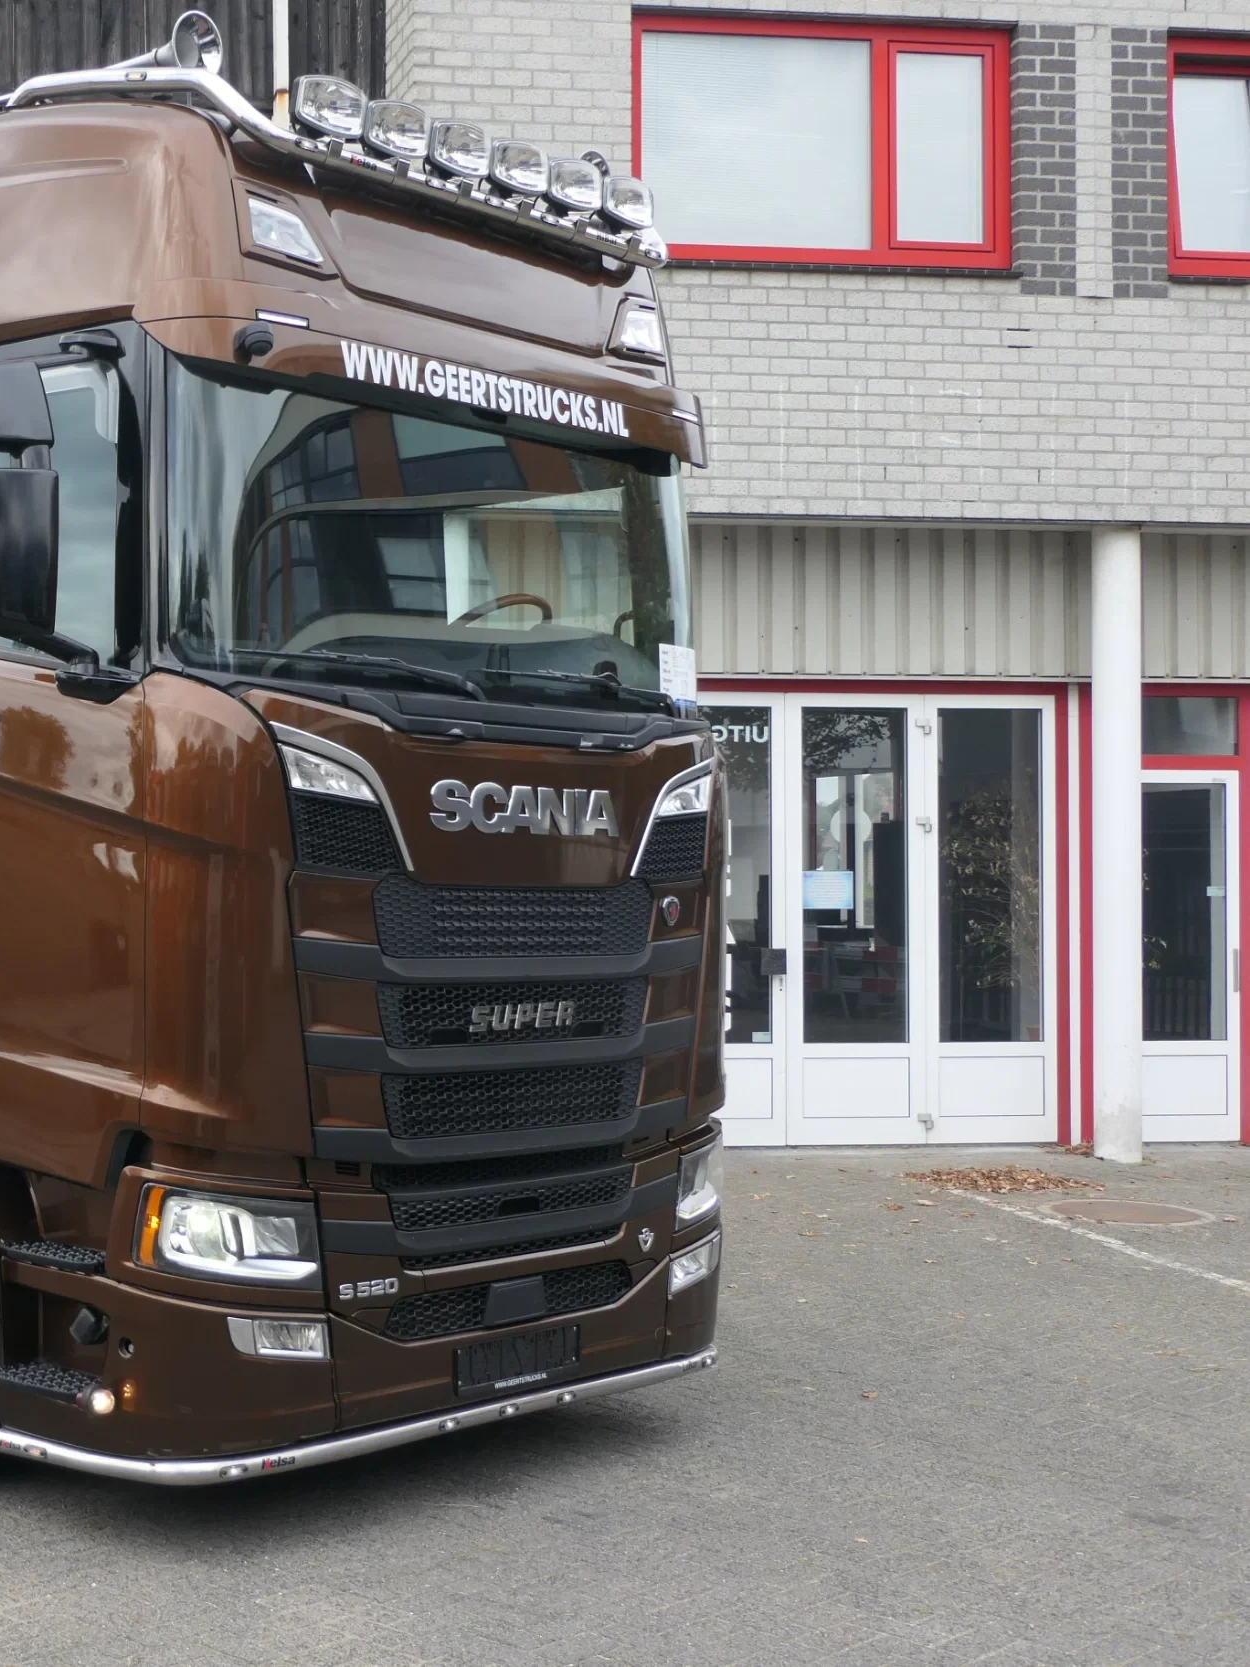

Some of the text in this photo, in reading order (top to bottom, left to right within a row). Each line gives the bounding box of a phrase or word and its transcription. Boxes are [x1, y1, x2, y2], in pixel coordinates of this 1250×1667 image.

[340, 341, 629, 437] WWW.GEERTSTRUCKS.NL
[429, 779, 619, 837] SCANIA
[469, 1001, 575, 1032] SUPER
[339, 1277, 398, 1300] S 520
